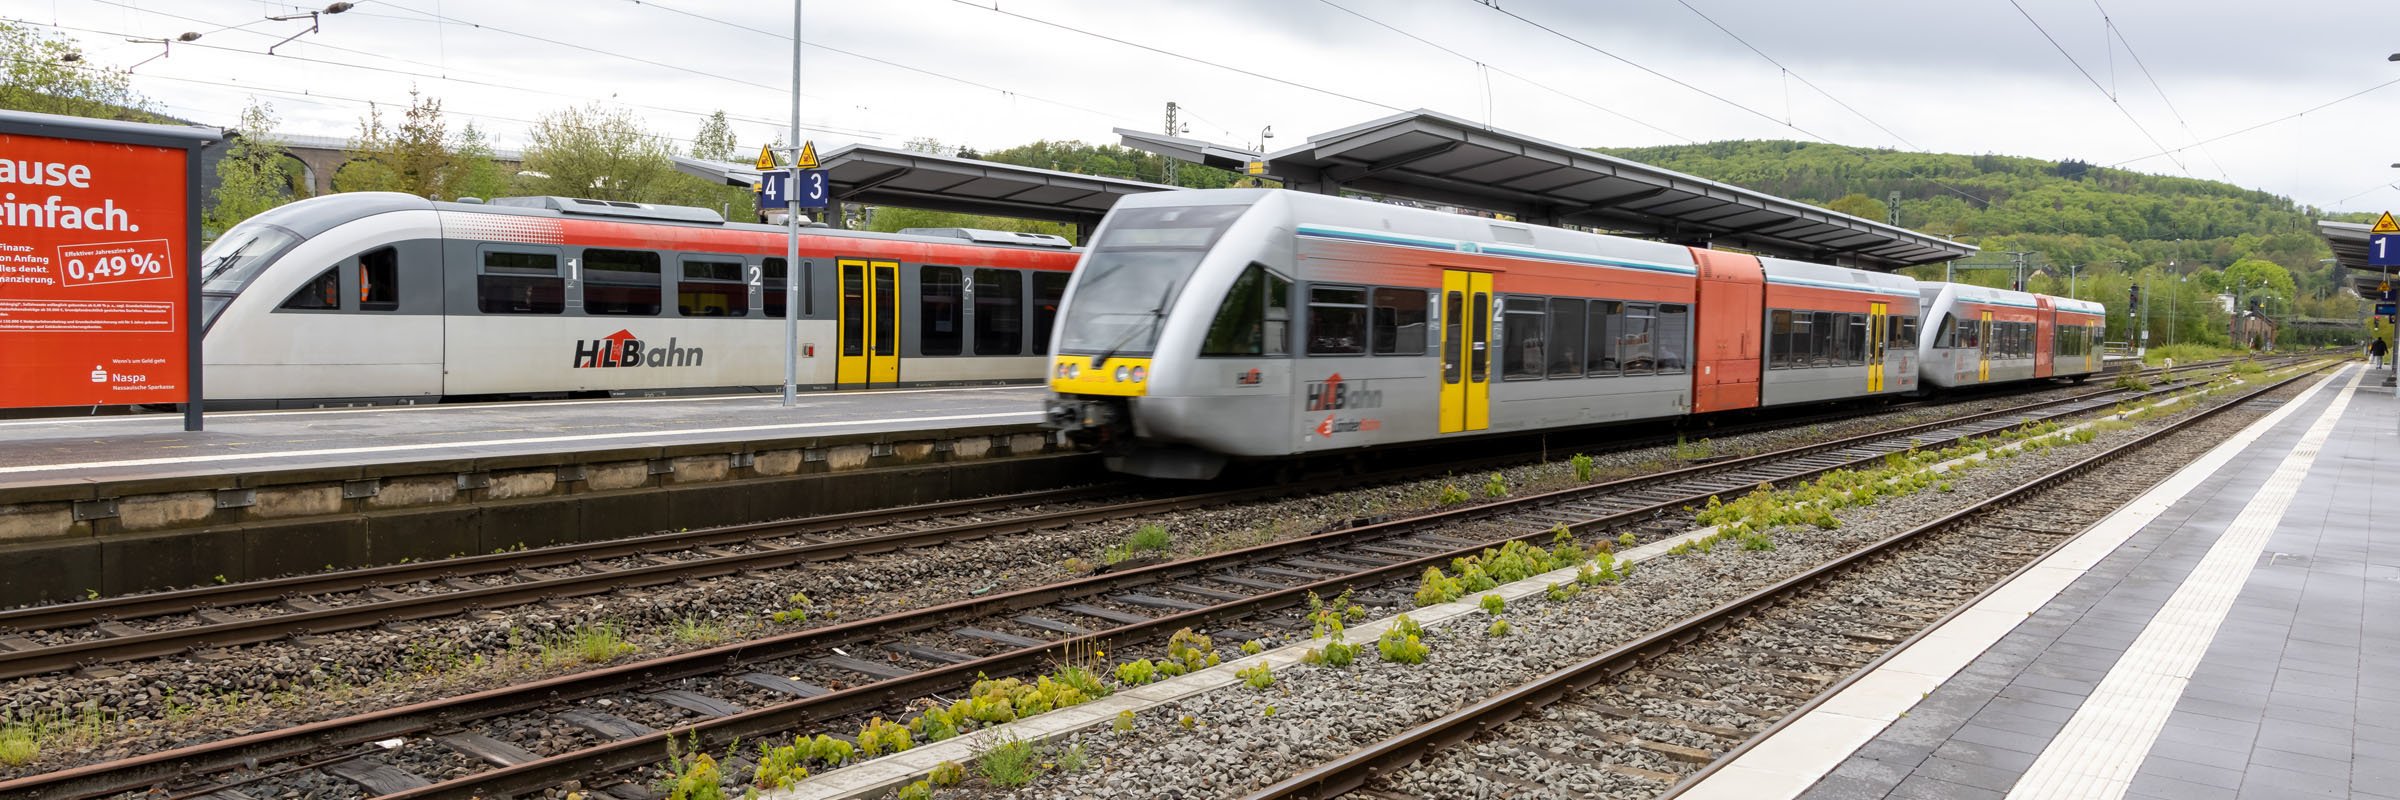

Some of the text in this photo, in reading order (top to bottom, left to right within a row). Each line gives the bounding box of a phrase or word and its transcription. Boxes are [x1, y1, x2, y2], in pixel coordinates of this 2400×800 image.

[0, 158, 91, 188] ause
[765, 175, 777, 200] 4
[810, 173, 822, 199] 3
[95, 248, 126, 256] Jahreszins
[2375, 237, 2387, 258] 1
[14, 254, 49, 264] Anfang
[19, 265, 49, 273] denkt.
[68, 256, 127, 281] 0,49
[567, 258, 577, 280] 1
[749, 266, 761, 286] 2
[964, 276, 972, 292] 2
[1430, 294, 1440, 319] 1
[1493, 298, 1504, 322] 2
[112, 373, 146, 384] Naspa
